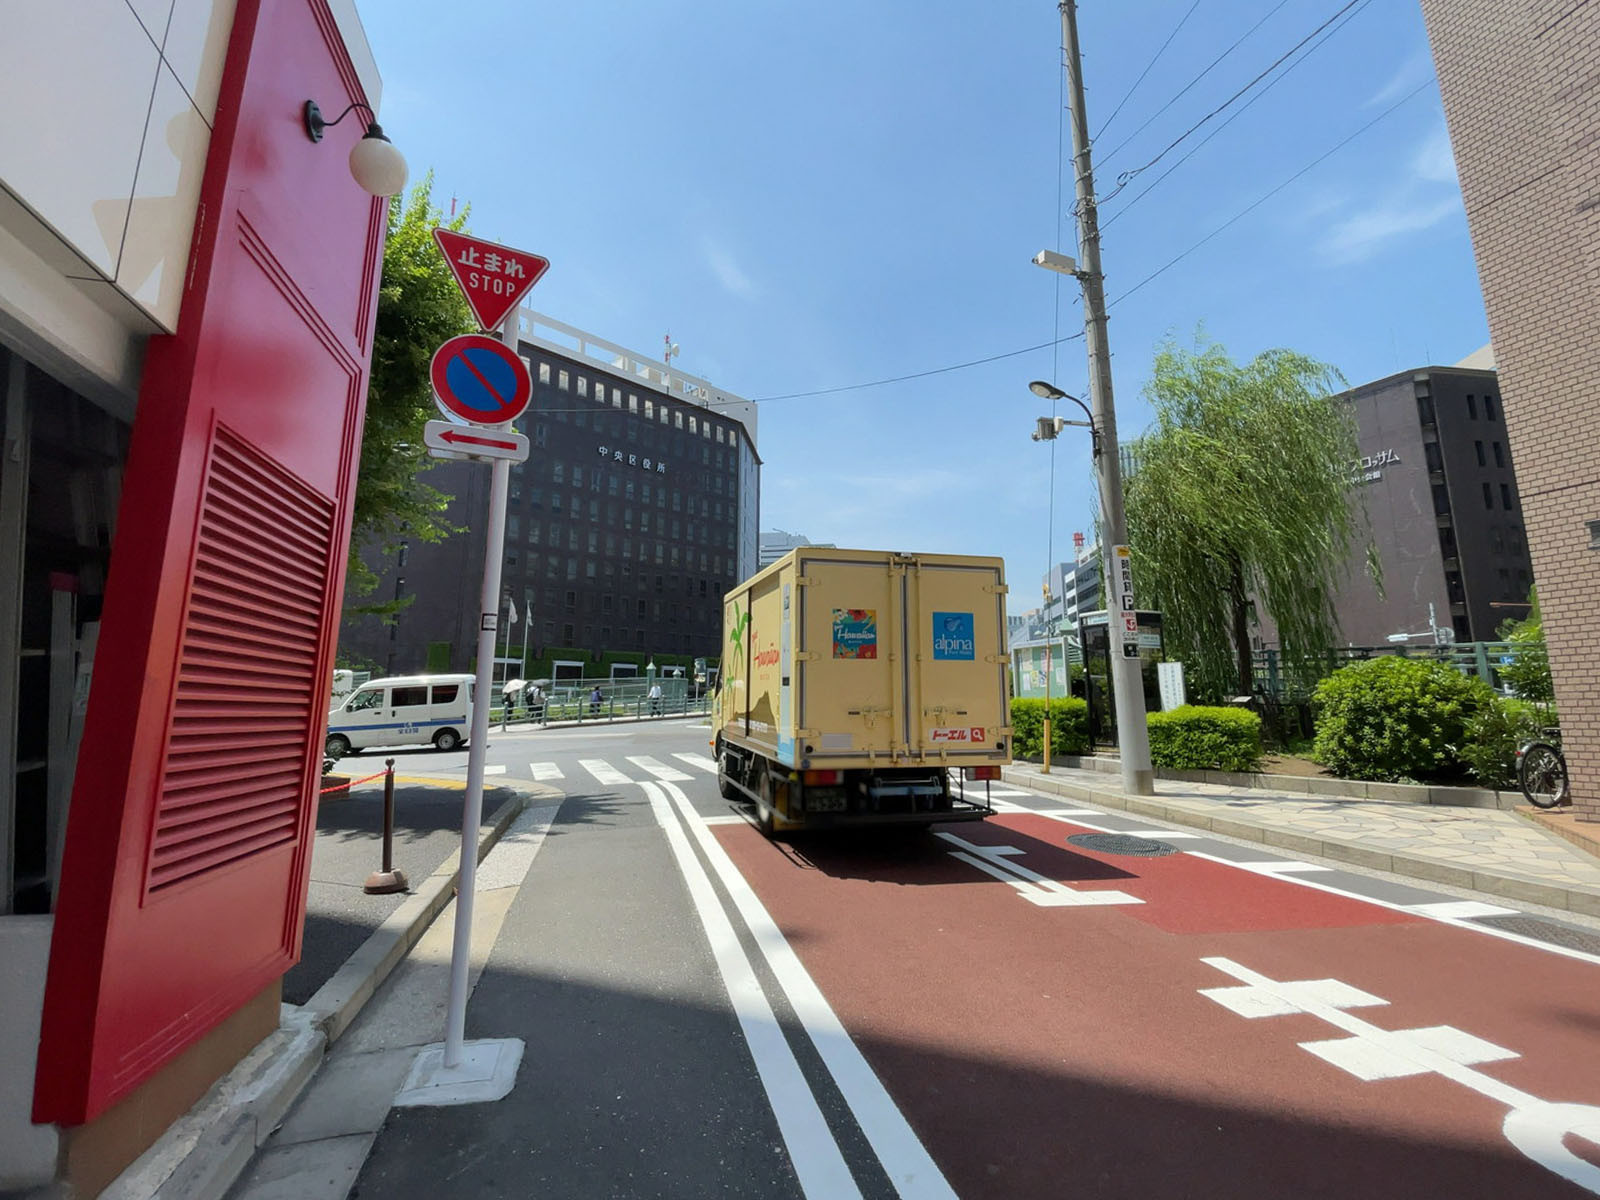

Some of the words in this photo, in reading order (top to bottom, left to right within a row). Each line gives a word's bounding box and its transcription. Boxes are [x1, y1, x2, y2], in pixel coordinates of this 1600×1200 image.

[457, 246, 526, 279] 止まれ
[468, 272, 517, 297] STOP
[598, 445, 666, 474] 中央区役所
[934, 633, 972, 655] alpina
[932, 729, 967, 741] トーエル
